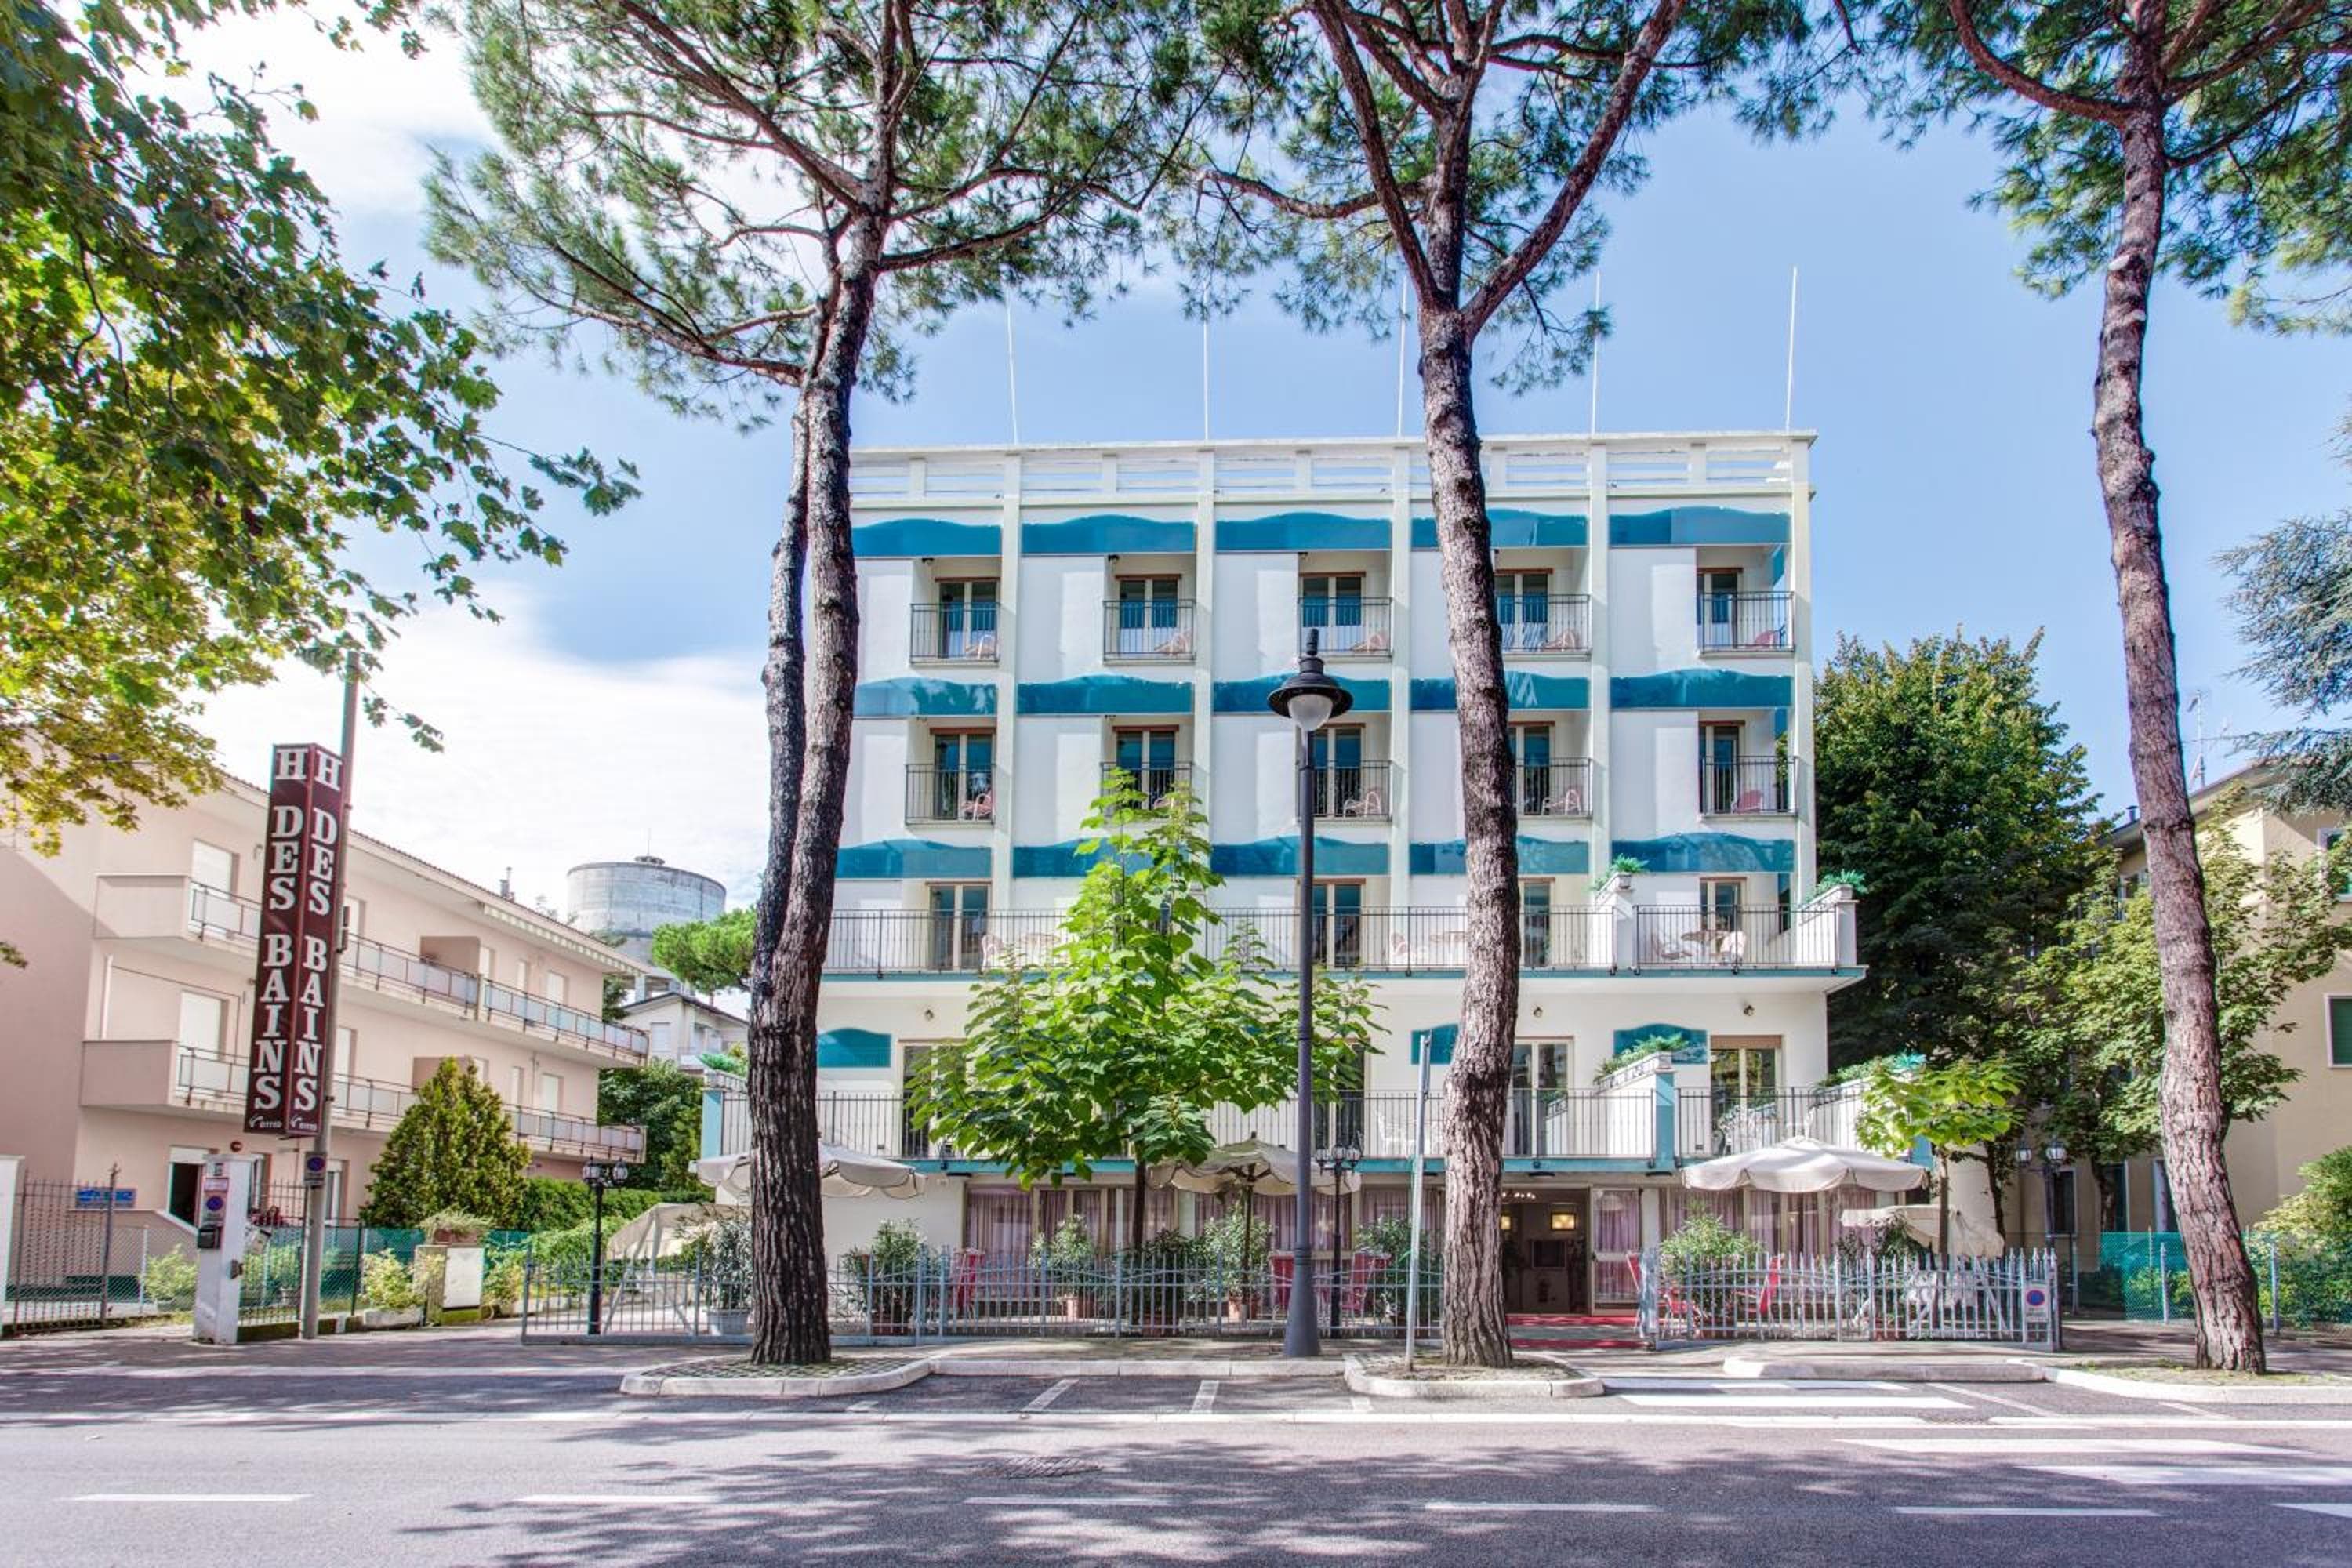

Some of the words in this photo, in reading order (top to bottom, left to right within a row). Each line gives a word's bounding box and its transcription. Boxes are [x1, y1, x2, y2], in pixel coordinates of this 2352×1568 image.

[275, 748, 308, 780] H
[313, 750, 342, 791] H
[269, 805, 303, 910] DES
[308, 807, 337, 916] DES
[254, 933, 292, 1110] BAINS
[294, 935, 327, 1111] BAINS
